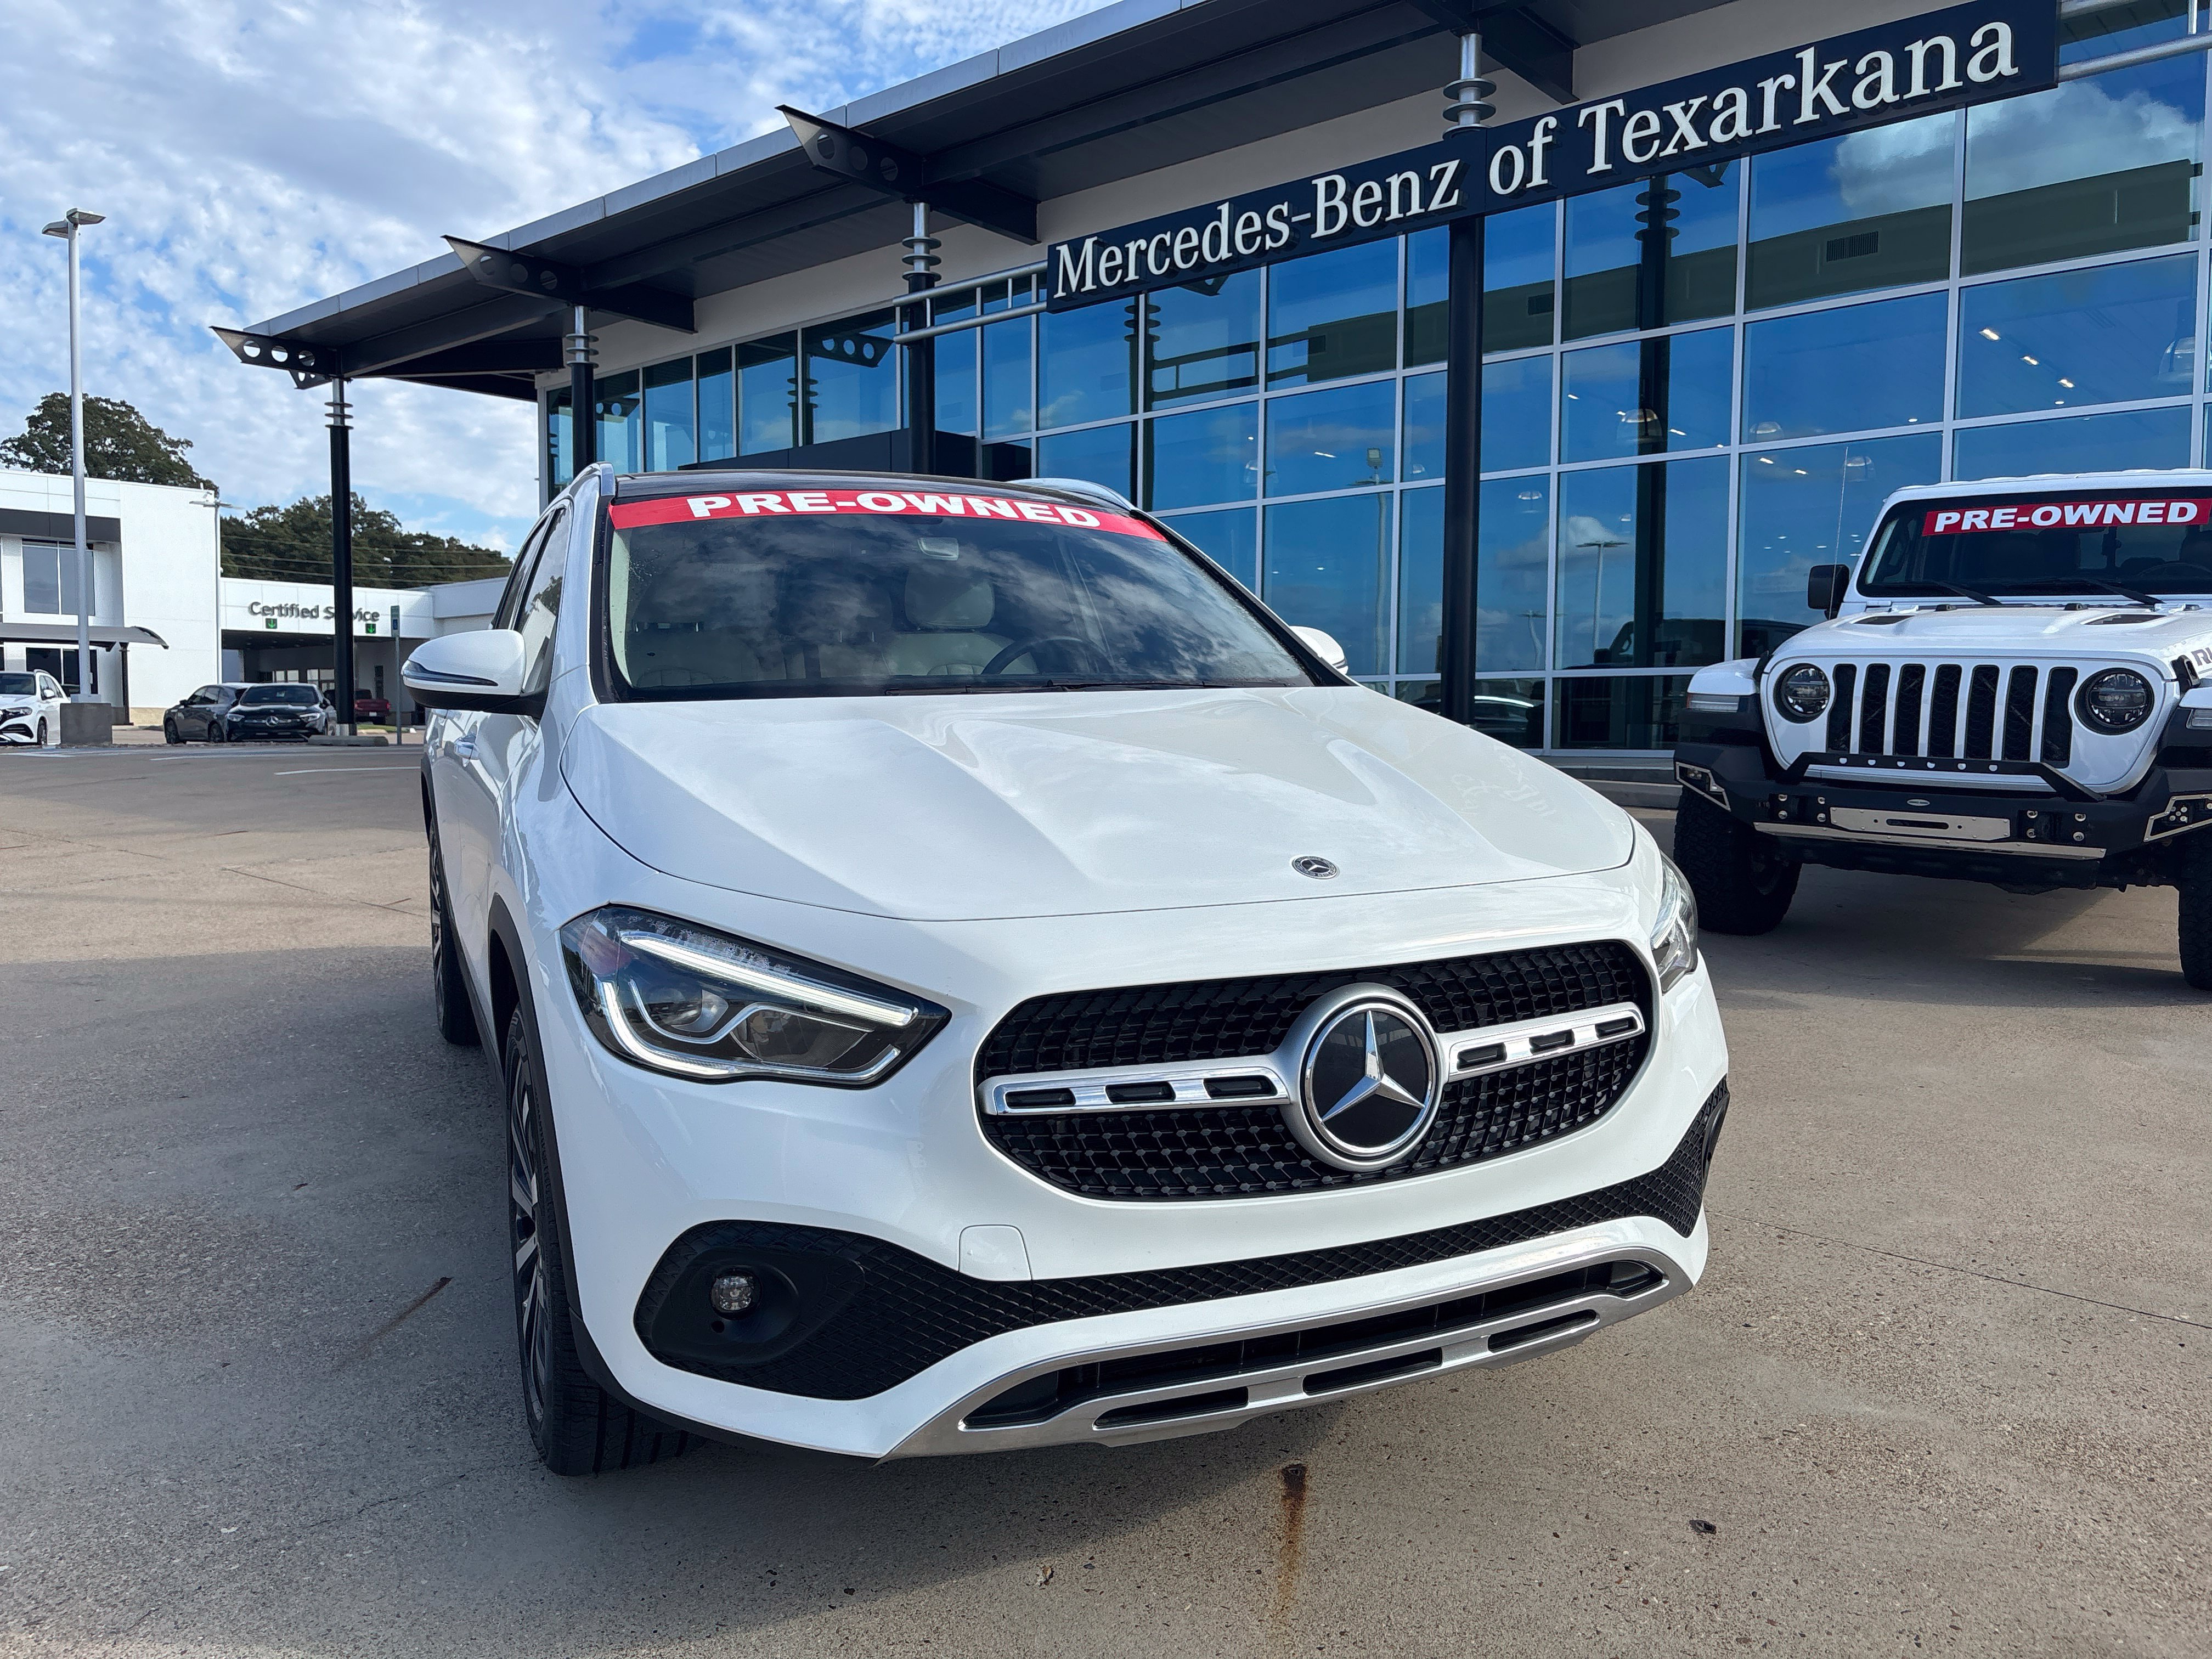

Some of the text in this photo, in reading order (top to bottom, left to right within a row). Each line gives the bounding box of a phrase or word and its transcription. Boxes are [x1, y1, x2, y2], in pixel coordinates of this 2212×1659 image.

[1052, 20, 2019, 298] Mercedes-Benz of Texarkana
[687, 492, 1101, 528] PRE-OWNED
[1934, 501, 2198, 533] PRE-OWNED
[248, 601, 319, 619] Certified
[323, 606, 380, 622] Svice
